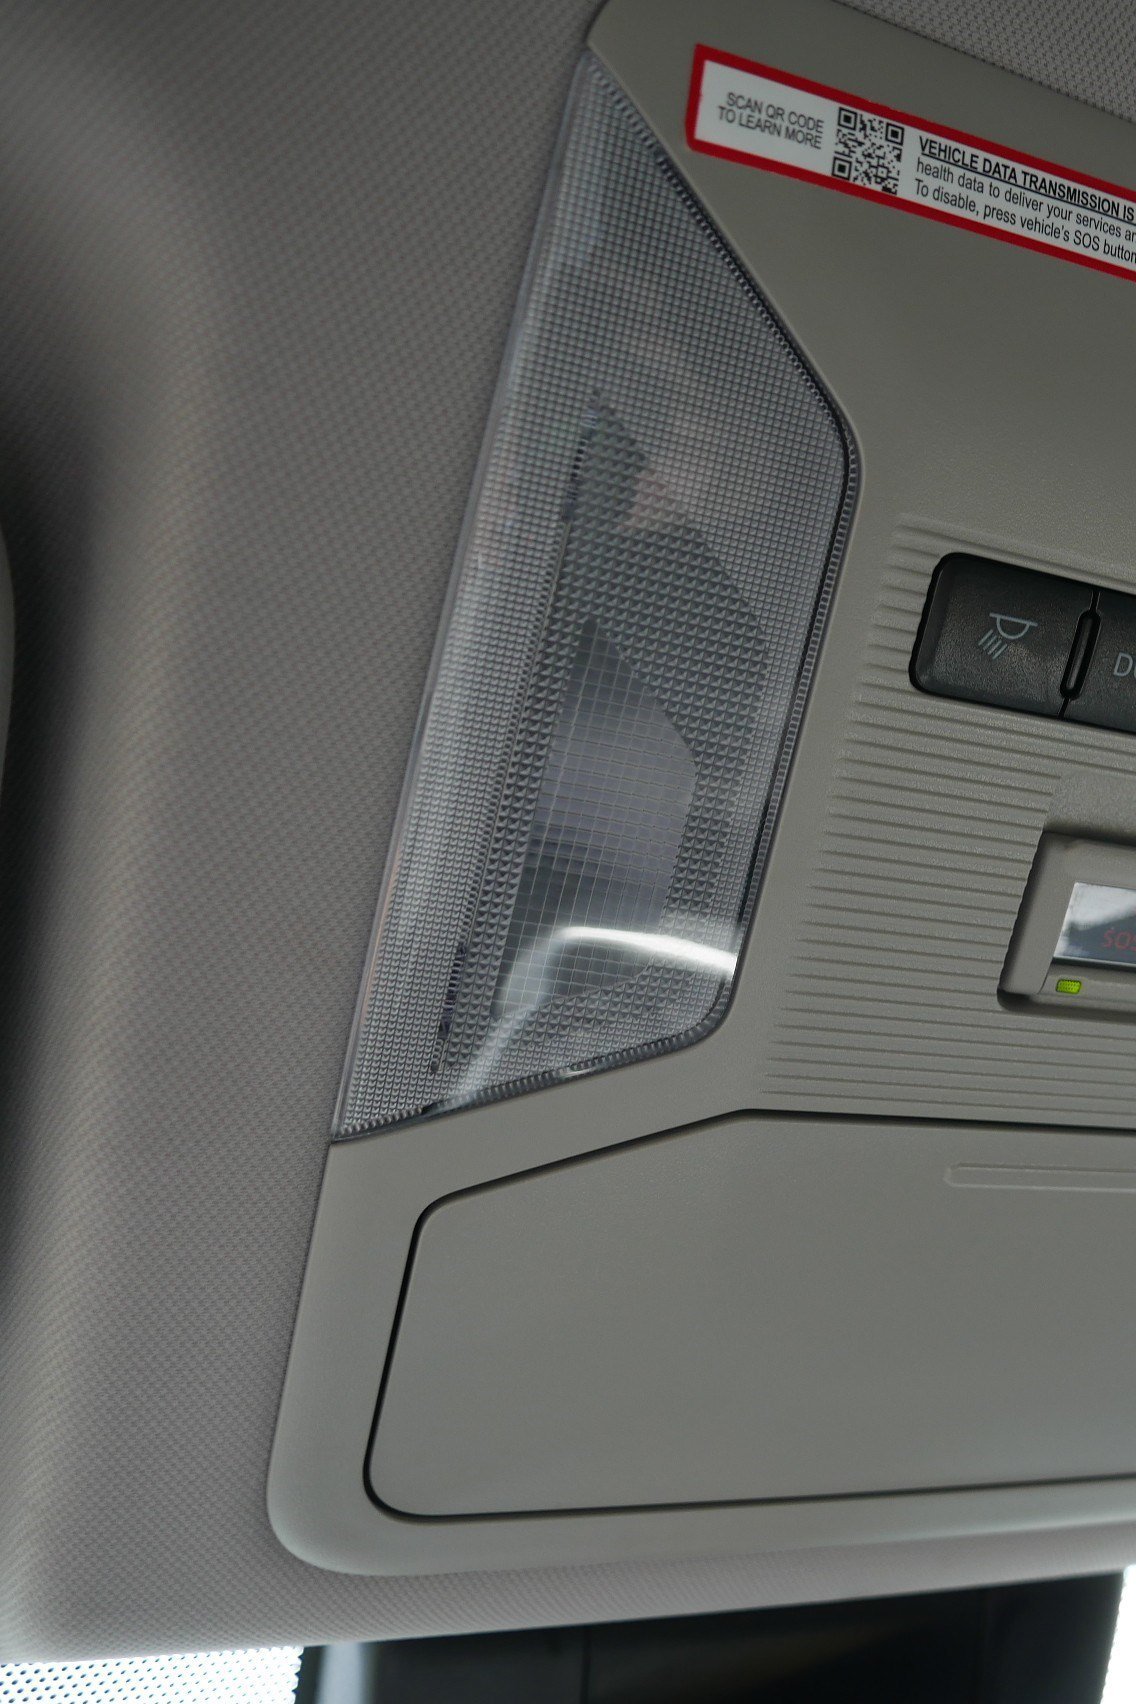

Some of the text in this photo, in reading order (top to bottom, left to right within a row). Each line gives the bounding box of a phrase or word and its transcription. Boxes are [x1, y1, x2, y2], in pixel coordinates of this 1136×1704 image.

[718, 106, 822, 150] TO LEARN MORE
[727, 92, 824, 134] SCAN QR CODE
[915, 178, 929, 197] To
[933, 187, 979, 216] disable,
[983, 203, 1016, 225] press
[1020, 215, 1070, 242] vehicle's
[1073, 230, 1100, 252] SOS
[917, 157, 954, 184] health
[958, 173, 984, 194] data
[989, 182, 1000, 198] to
[1004, 189, 1043, 212] deliver
[1046, 203, 1073, 222] your
[1075, 212, 1122, 238] services
[919, 135, 979, 170] VEHICLE
[982, 158, 1018, 183] DATA
[1021, 171, 1120, 217] TRANSMISSION
[1123, 205, 1135, 222] IS
